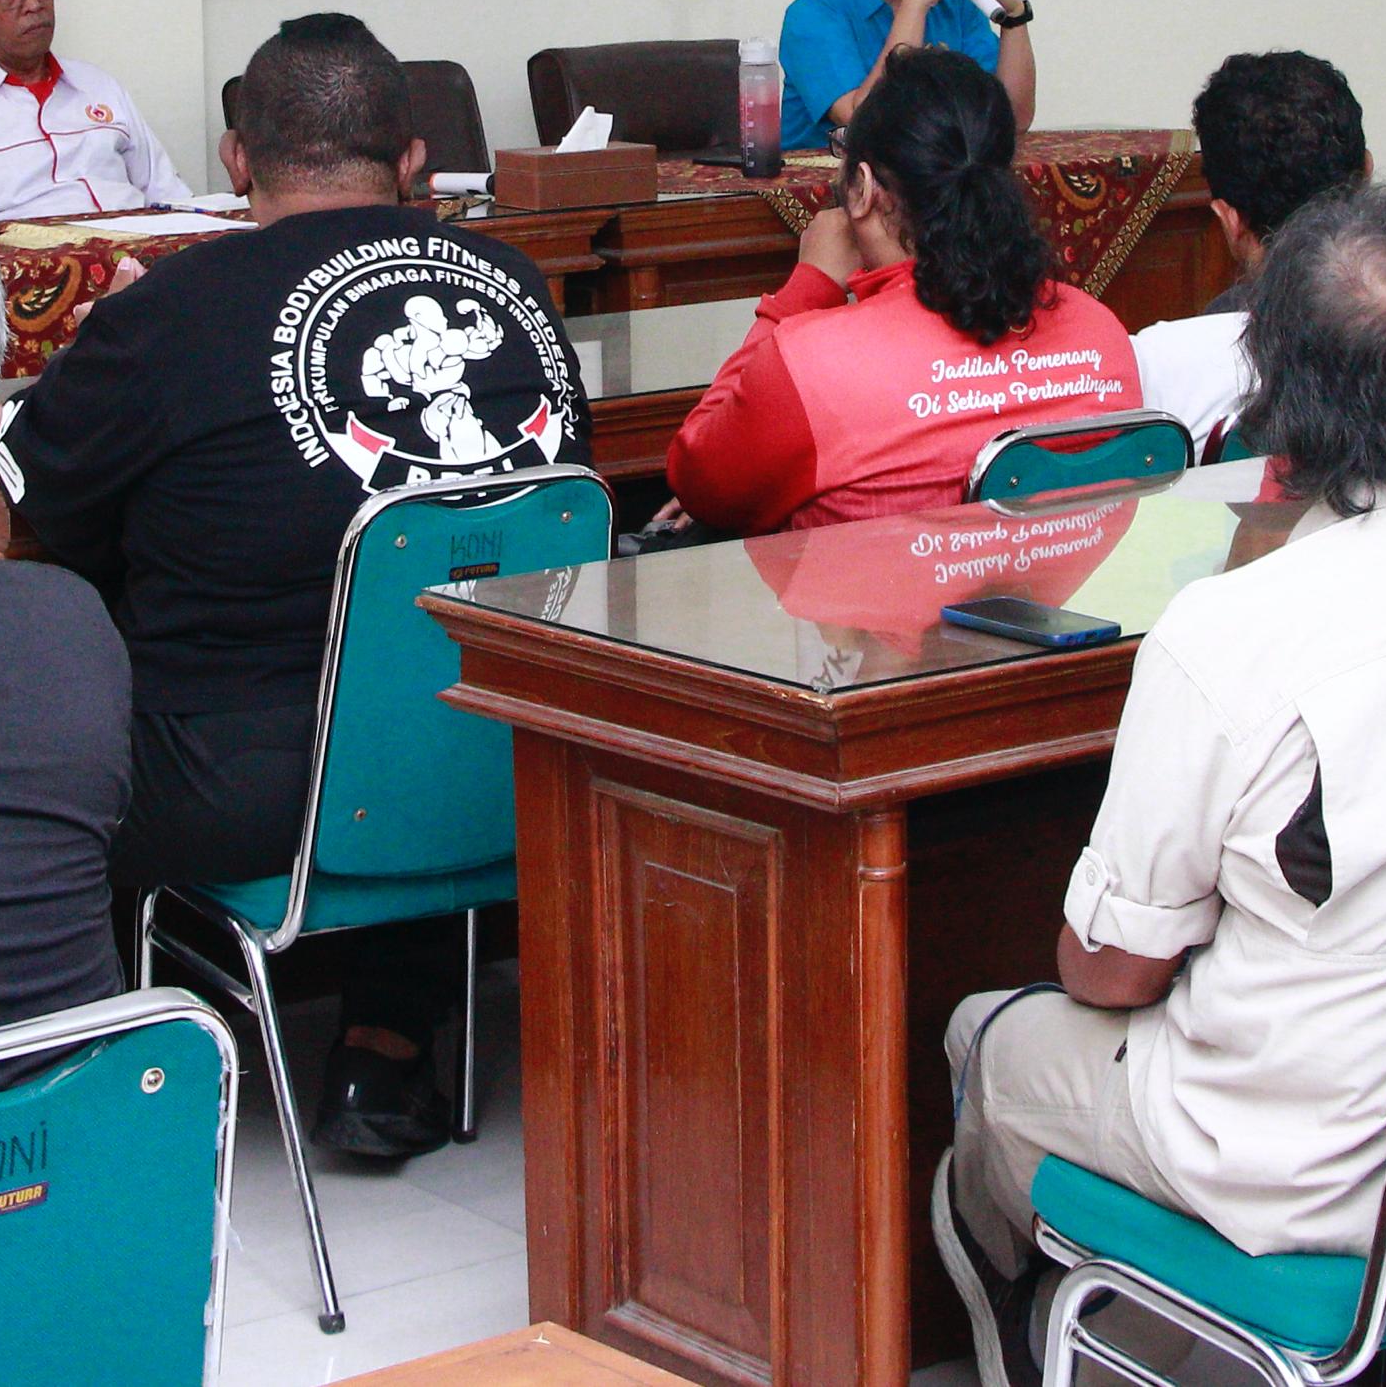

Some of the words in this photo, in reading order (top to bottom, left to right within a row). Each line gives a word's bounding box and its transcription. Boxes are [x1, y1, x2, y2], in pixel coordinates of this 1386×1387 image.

[273, 236, 420, 344] BODYBUILDING
[427, 237, 522, 295] FITNESS
[346, 268, 433, 302] BINARAGA
[435, 270, 508, 306] FITNESS
[931, 353, 1008, 384] Jadilah
[1011, 347, 1102, 372] Pemenang
[908, 391, 942, 418] Di
[946, 389, 1006, 415] Setiap
[1009, 374, 1123, 404] Pertandingan
